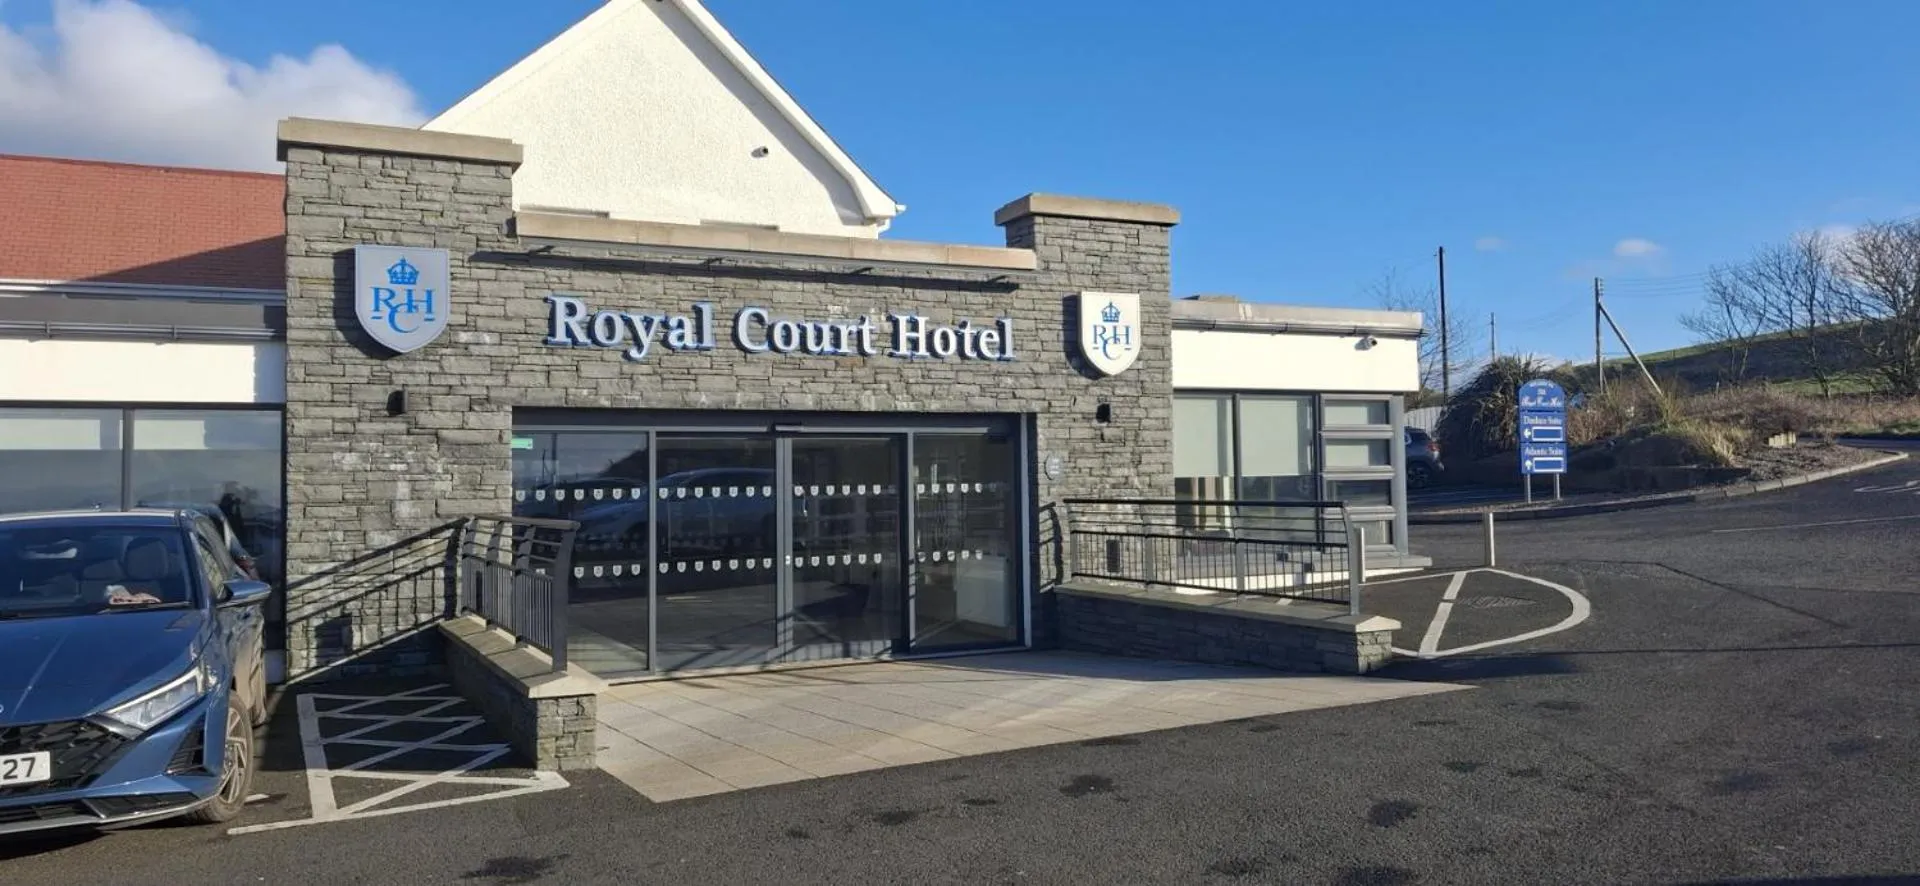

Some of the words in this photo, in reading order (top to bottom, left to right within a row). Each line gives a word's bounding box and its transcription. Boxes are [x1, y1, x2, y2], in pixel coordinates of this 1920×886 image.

[544, 294, 715, 360] Royal
[733, 305, 877, 355] Court
[887, 313, 1017, 361] Hotel
[2, 756, 36, 780] 27
